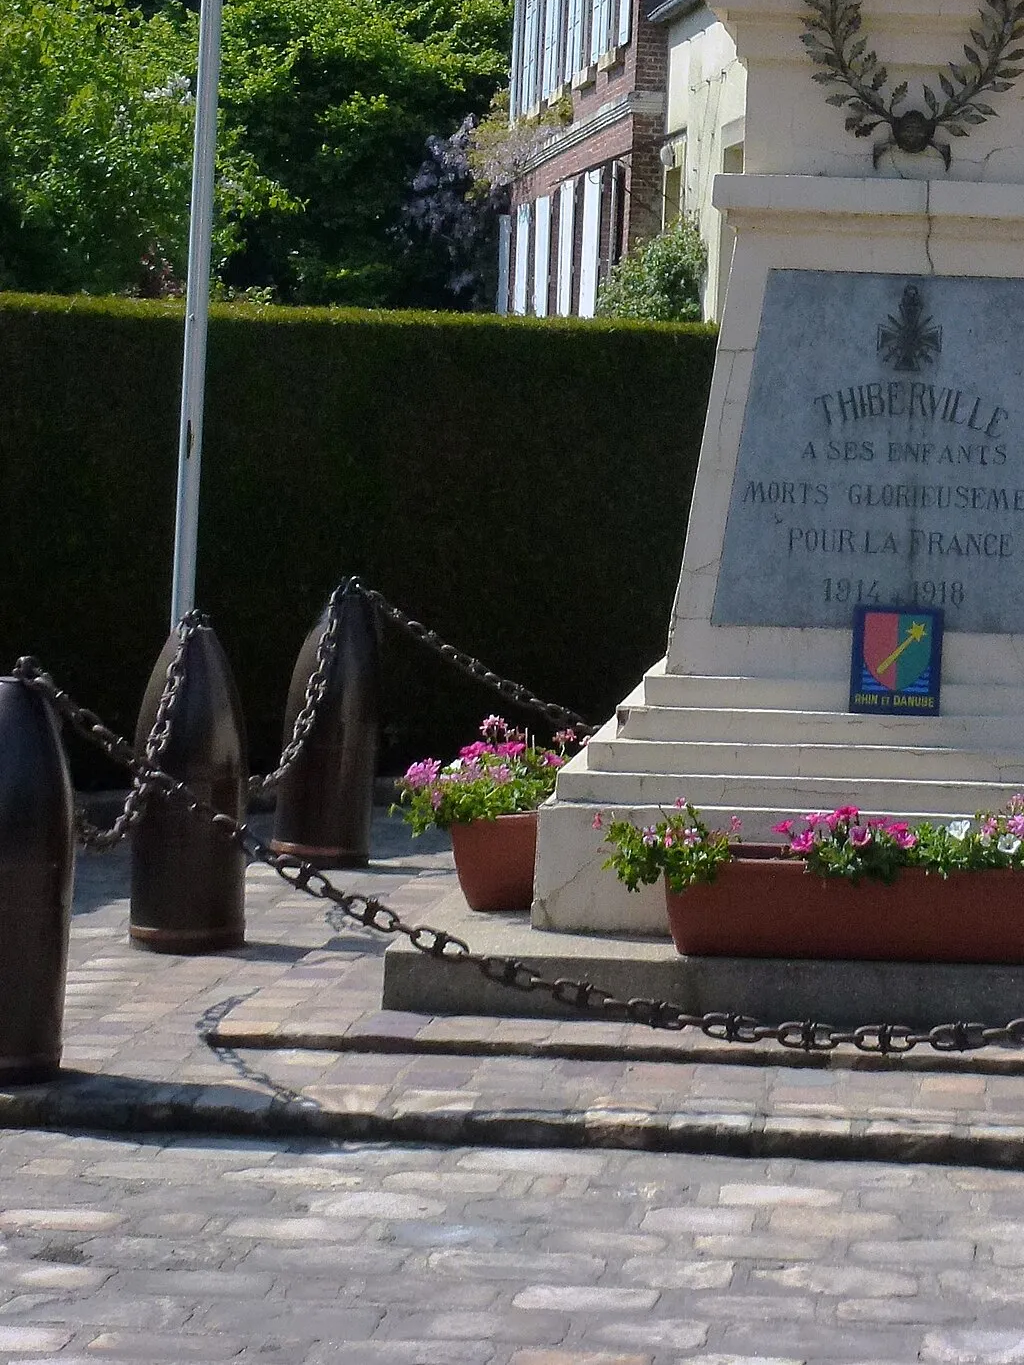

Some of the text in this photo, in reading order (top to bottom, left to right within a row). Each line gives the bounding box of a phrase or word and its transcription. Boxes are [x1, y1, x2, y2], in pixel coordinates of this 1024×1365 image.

[813, 382, 1009, 438] THIBERVILLE
[802, 441, 1008, 466] A SES ENFANTS
[742, 480, 830, 506] MORTS
[788, 528, 1014, 558] POUR LA FRANCE
[823, 577, 966, 609] 1914 1918
[855, 694, 935, 708] RHIN ET DANUBE
